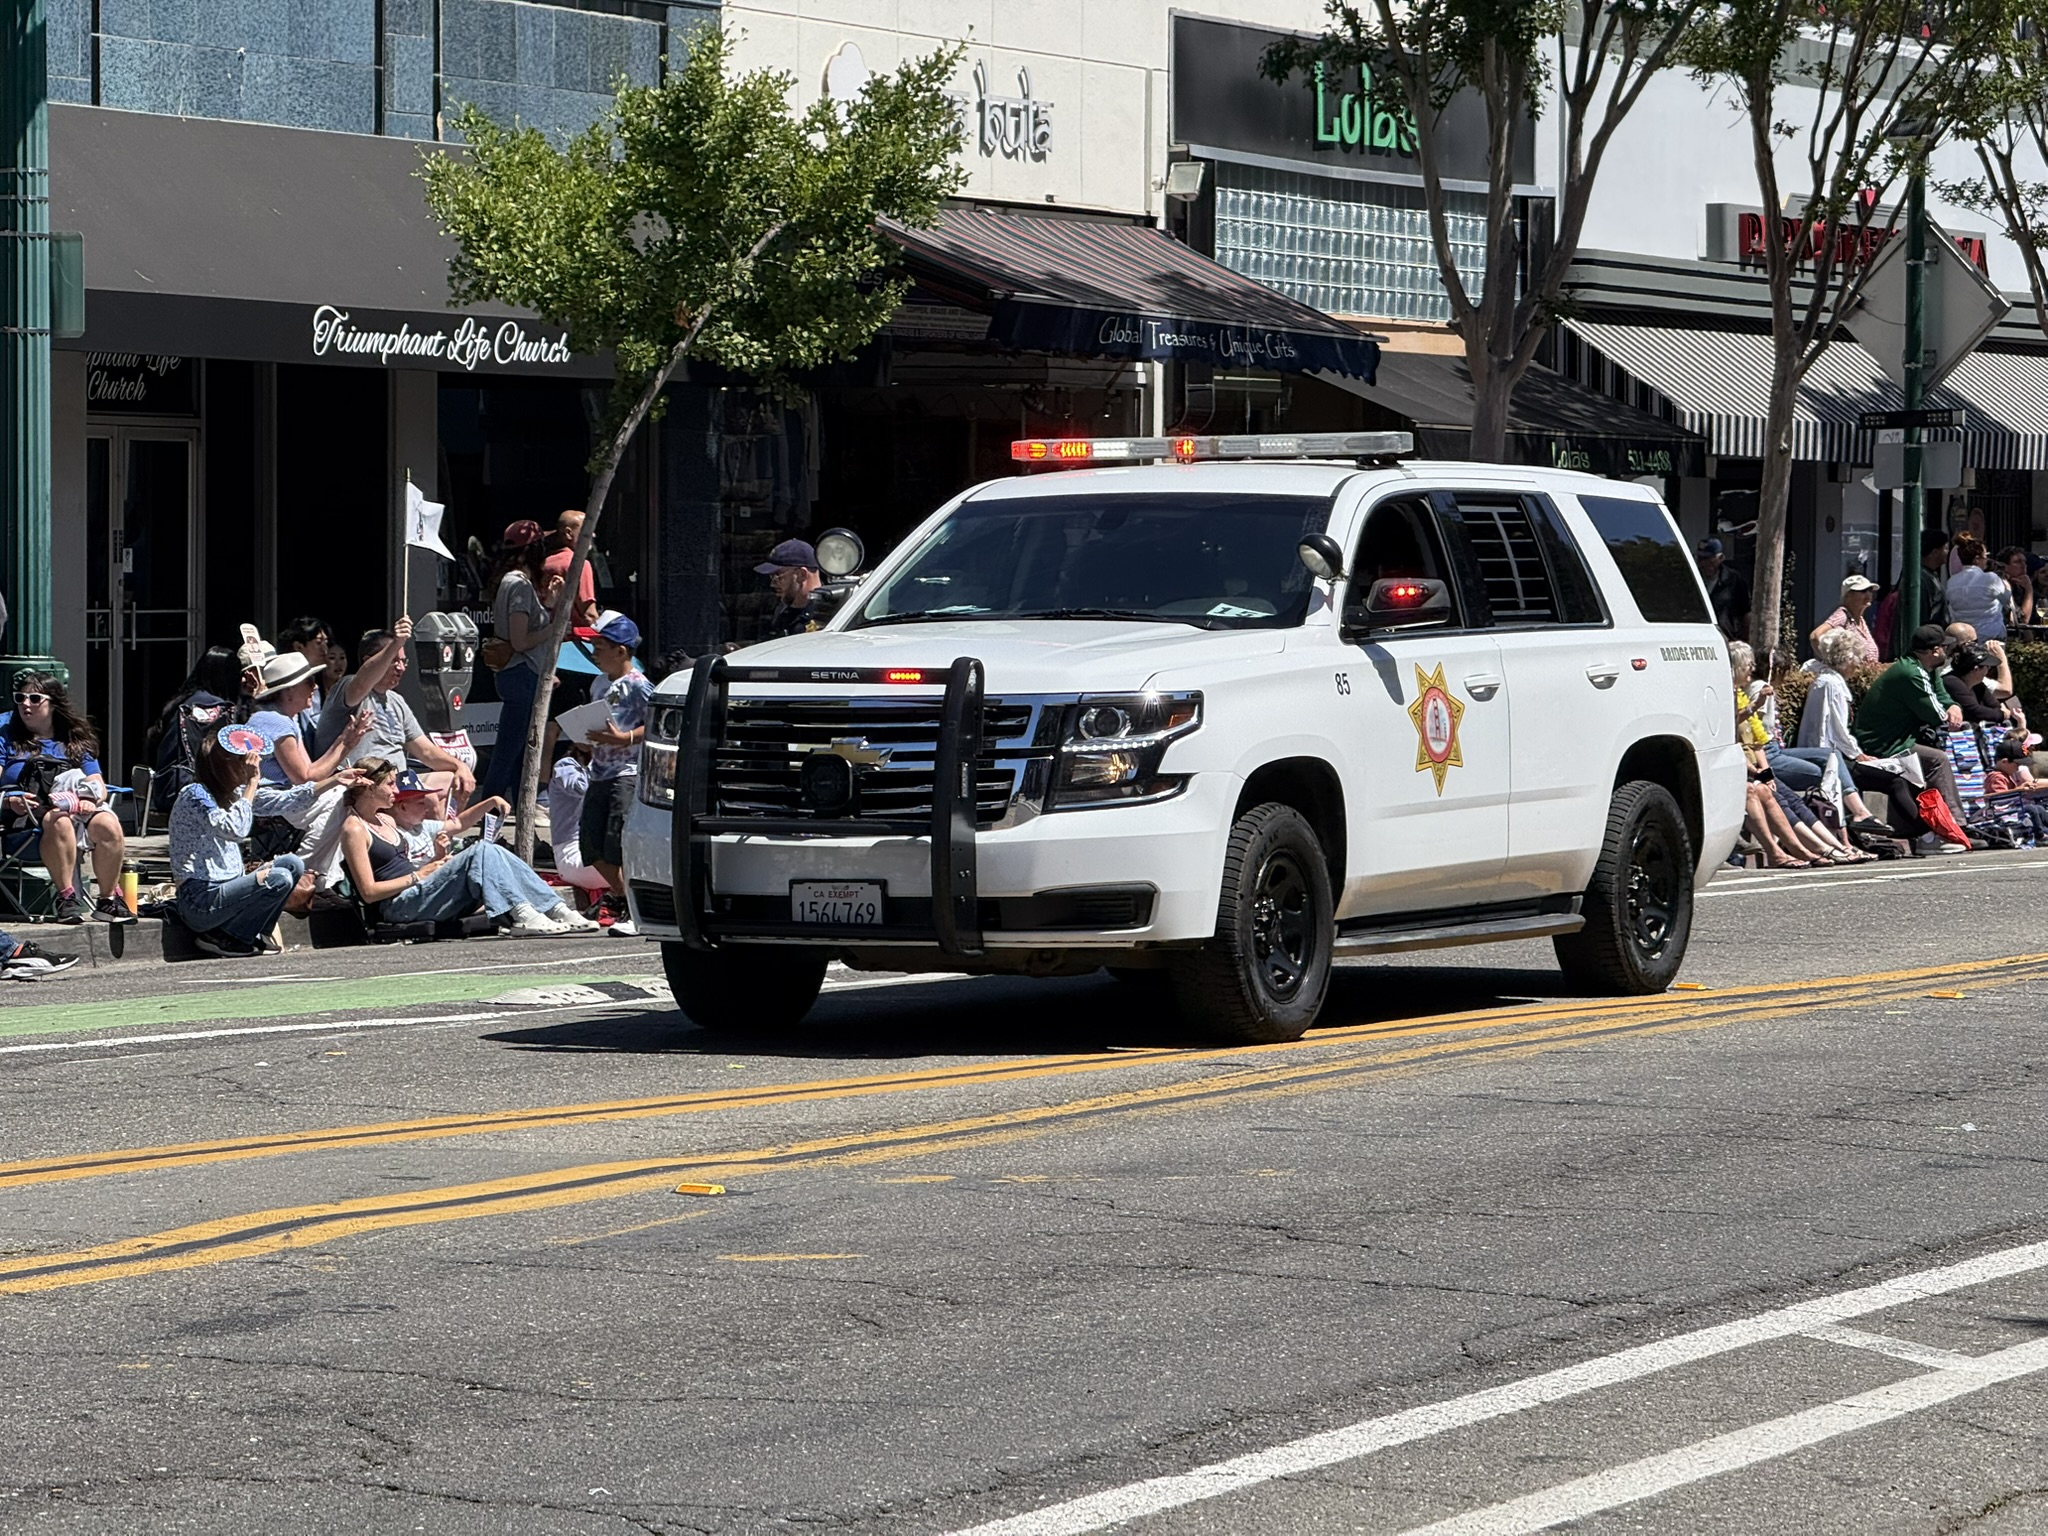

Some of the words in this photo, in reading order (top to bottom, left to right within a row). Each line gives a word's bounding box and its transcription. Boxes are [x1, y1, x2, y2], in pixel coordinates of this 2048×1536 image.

[313, 305, 446, 364] Triumphant
[447, 317, 491, 370] Life
[494, 321, 571, 364] Church
[1099, 316, 1142, 344] Global
[1147, 321, 1208, 349] Treasures
[1220, 329, 1265, 364] Unique
[88, 370, 146, 400] Church
[1660, 647, 1690, 661] BRIDGE
[1689, 646, 1718, 661] PATROL
[811, 671, 859, 680] SETINA
[1335, 673, 1351, 695] 85
[813, 890, 824, 898] CA
[828, 890, 859, 899] EXEMPT
[799, 901, 876, 923] 1564769
